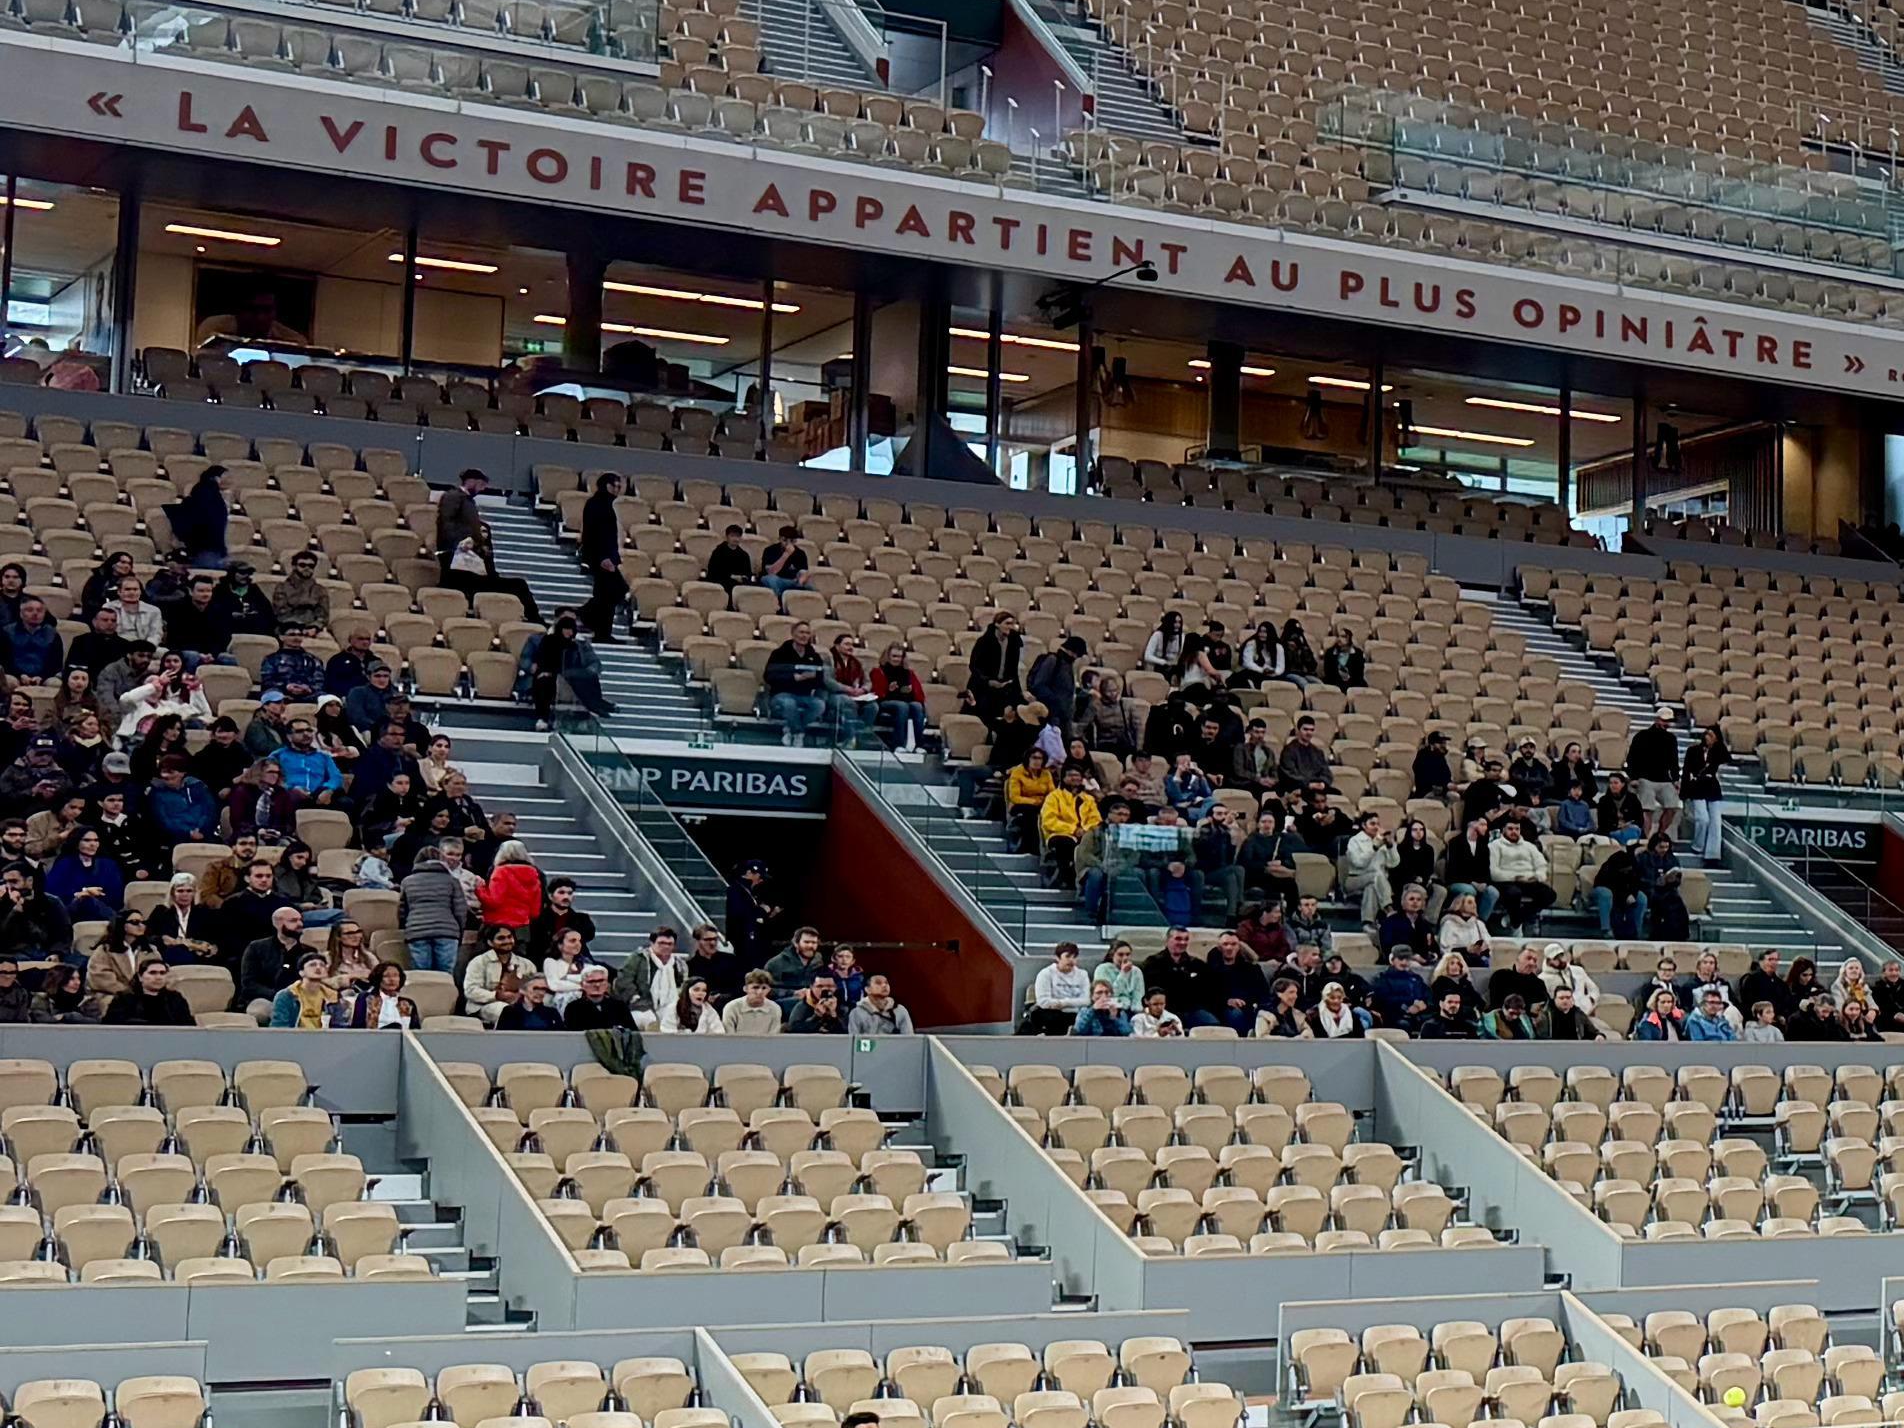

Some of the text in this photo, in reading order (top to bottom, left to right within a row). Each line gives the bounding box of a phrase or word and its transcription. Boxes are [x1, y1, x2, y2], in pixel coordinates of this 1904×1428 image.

[178, 91, 269, 143] LA
[319, 115, 707, 205] VICTOIRE
[753, 182, 1188, 275] APPARTIENT
[1224, 254, 1299, 293] AU
[1339, 271, 1477, 320] PLUS
[1513, 297, 1812, 370] OPINIÂTRE
[671, 769, 808, 797] PARIBAS
[1771, 826, 1867, 849] PARIBAS
